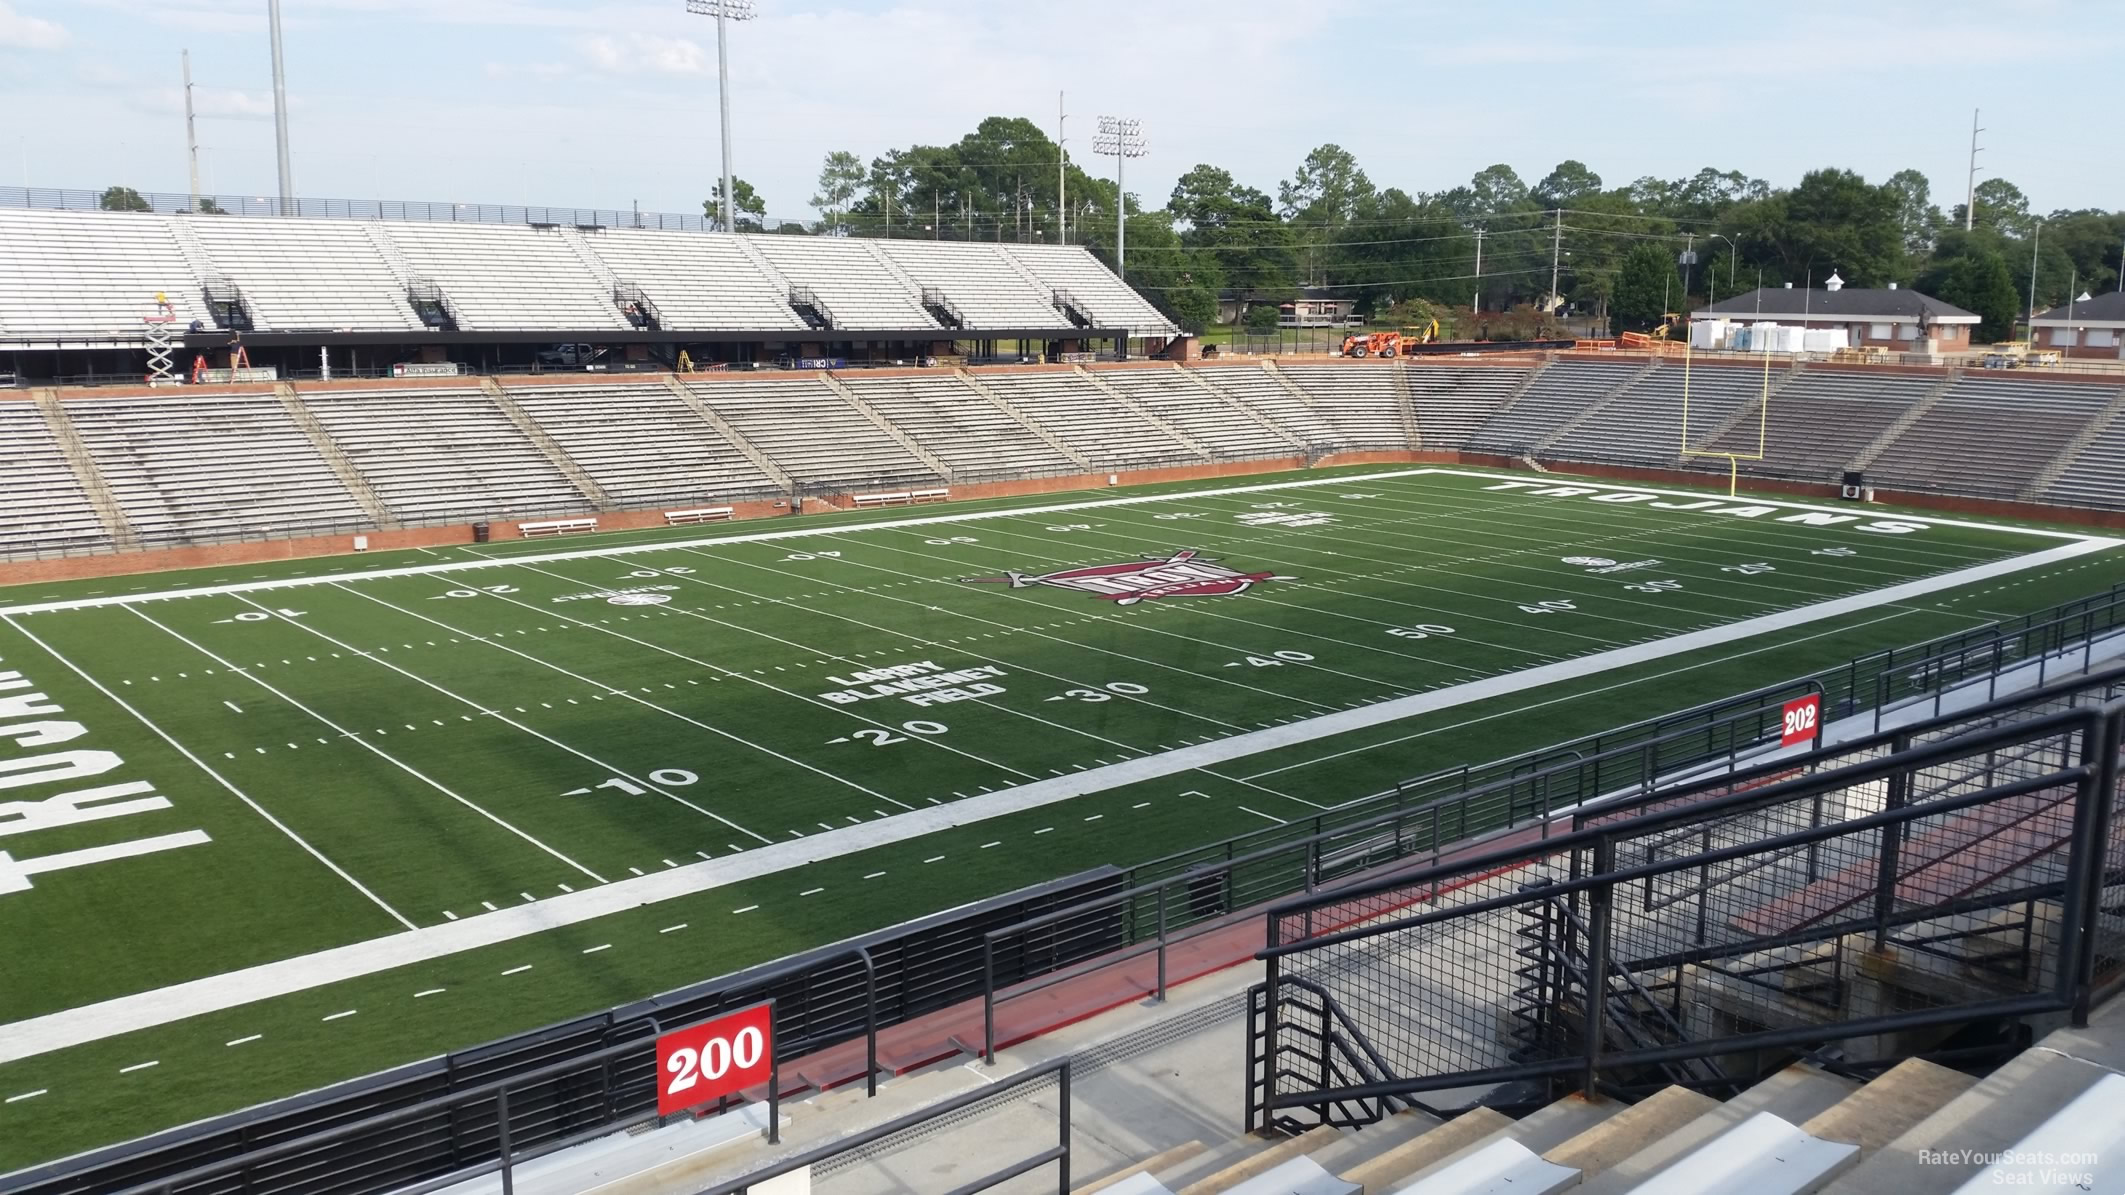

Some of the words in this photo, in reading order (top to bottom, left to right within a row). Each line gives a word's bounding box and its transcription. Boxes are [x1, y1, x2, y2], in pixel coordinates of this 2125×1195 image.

[1481, 481, 1931, 534] TROJANS
[445, 585, 520, 598] 20
[1073, 565, 1226, 592] TROY
[235, 608, 308, 622] 10
[1518, 600, 1577, 614] 40
[1384, 623, 1455, 640] 50
[1245, 650, 1315, 669] 40
[817, 665, 1009, 704] BLAKENEY
[825, 660, 945, 686] LARRY
[900, 683, 1006, 707] FIELD
[1065, 682, 1149, 702] 30
[853, 720, 949, 746] 20
[1784, 704, 1816, 736] 202
[596, 768, 699, 796] 10
[666, 1026, 764, 1095] 200
